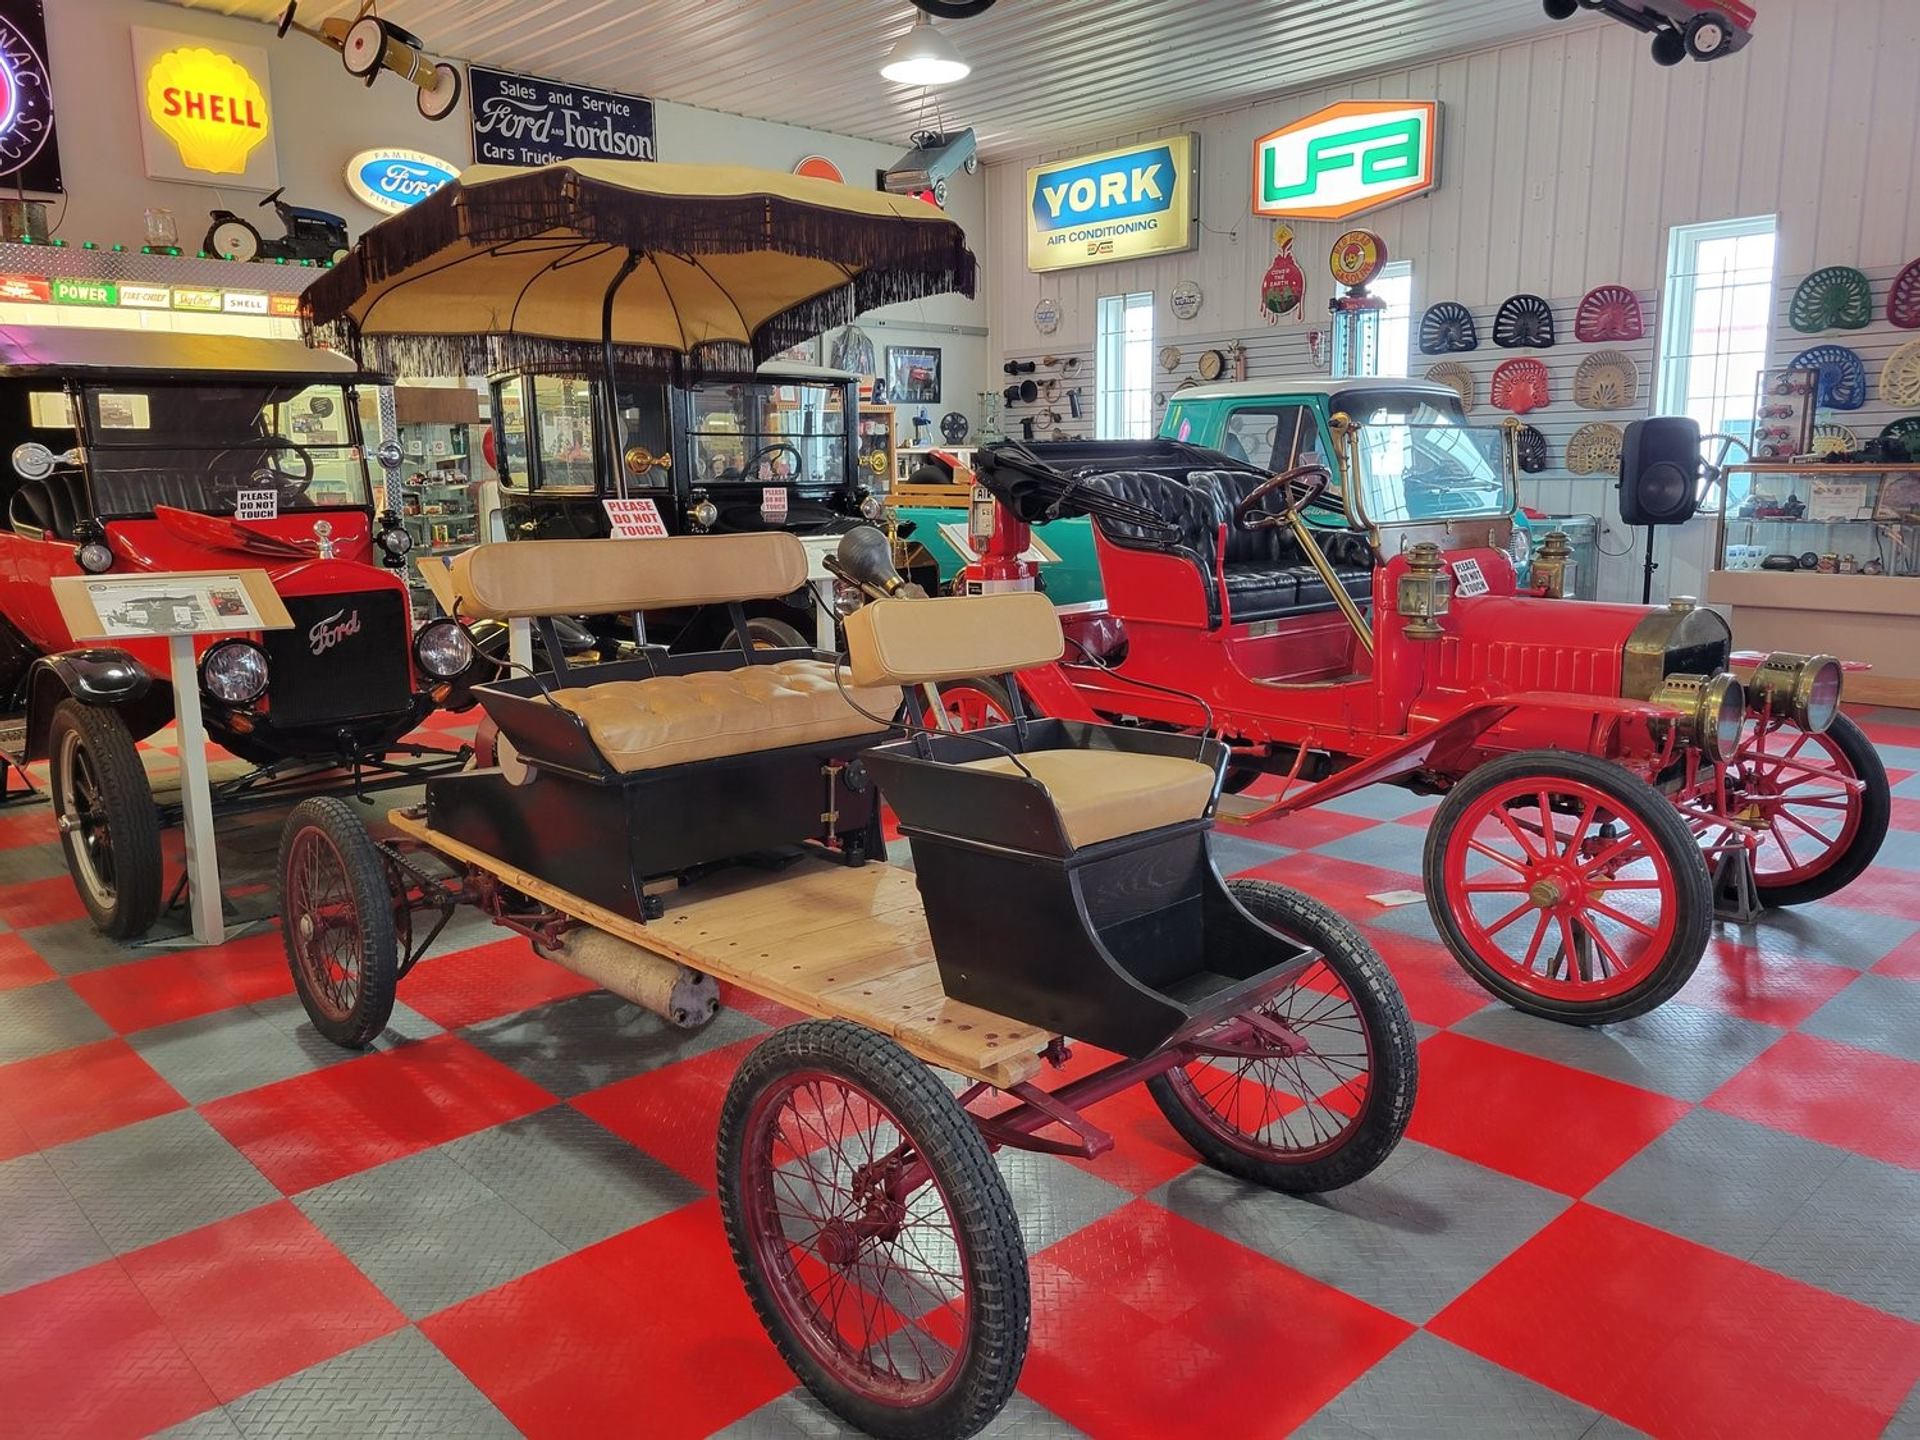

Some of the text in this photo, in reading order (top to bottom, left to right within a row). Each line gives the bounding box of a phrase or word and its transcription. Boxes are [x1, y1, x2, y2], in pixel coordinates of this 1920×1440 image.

[499, 80, 630, 117] Sales and Service
[163, 87, 261, 129] SHELL
[475, 96, 654, 160] Ford AND Fordson
[483, 142, 515, 161] Cars
[374, 151, 452, 172] FAMILY OF
[380, 164, 447, 198] Ford
[1042, 163, 1163, 218] YORK
[1047, 218, 1159, 246] AIR CONDITIONING
[1271, 268, 1291, 276] COVER
[1270, 280, 1289, 288] EARTH
[60, 285, 107, 302] POWER
[229, 299, 262, 309] SHELL
[241, 492, 275, 501] PLEASE
[240, 501, 274, 510] DO NOT
[607, 500, 654, 511] PLEASE
[240, 510, 274, 519] TOUCH
[613, 513, 659, 524] DO NOT
[619, 525, 663, 536] TOUCH
[1455, 560, 1477, 573] PLEASE
[1460, 570, 1482, 583] DO NOT
[1465, 581, 1487, 593] TOUCH
[309, 608, 361, 655] Ford
